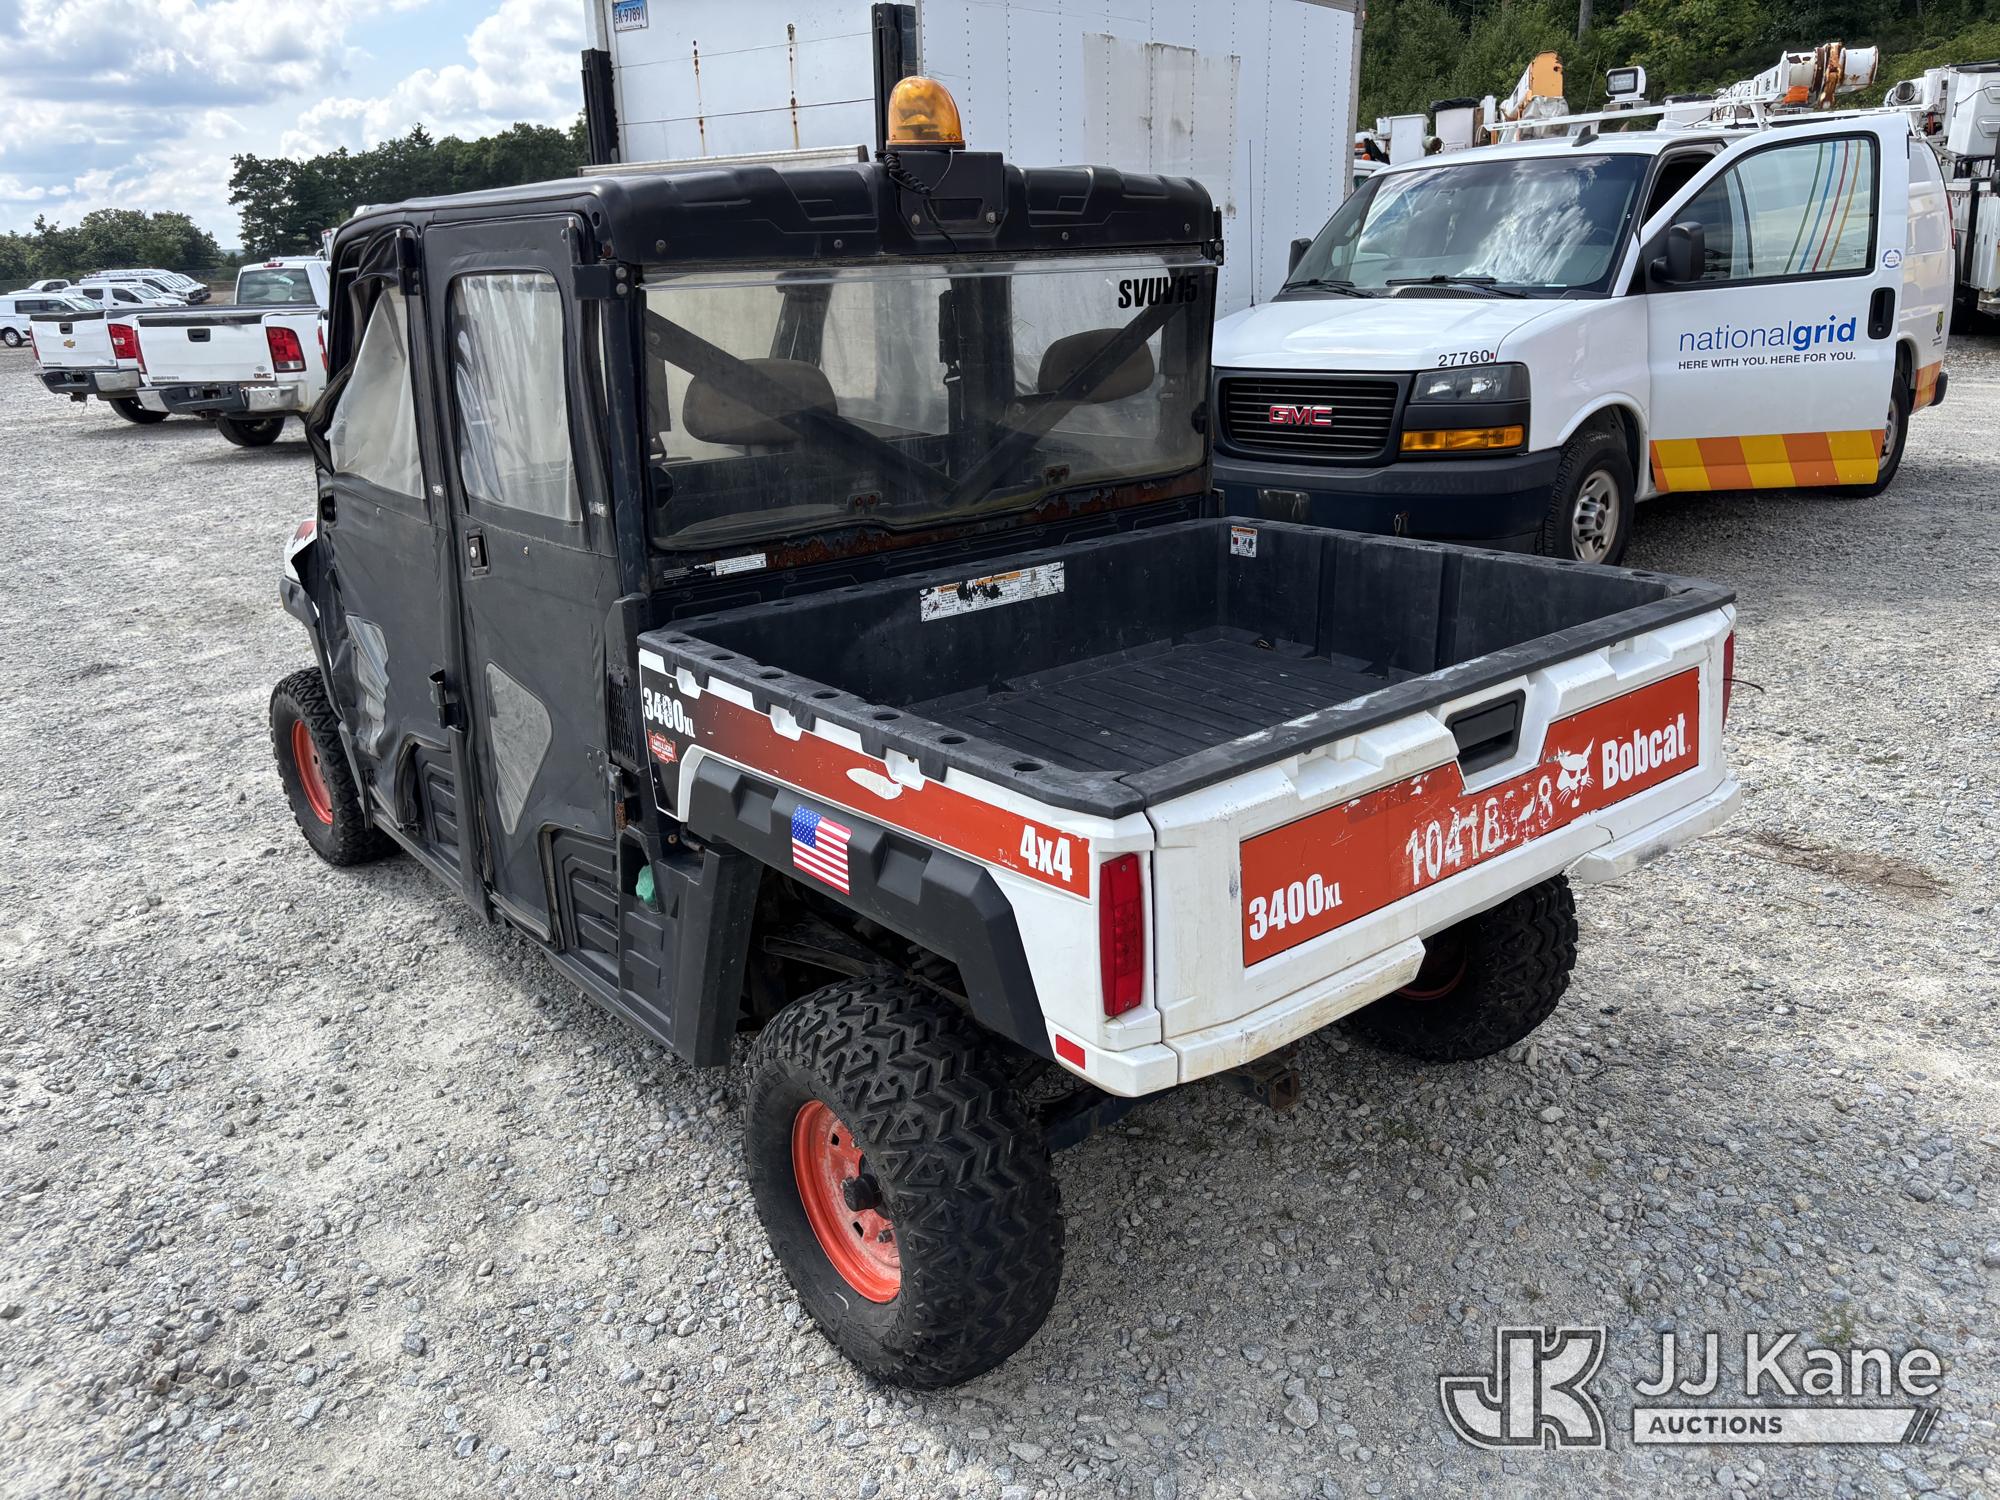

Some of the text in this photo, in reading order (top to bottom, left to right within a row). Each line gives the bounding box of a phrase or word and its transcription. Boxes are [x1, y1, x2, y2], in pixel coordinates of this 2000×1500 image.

[1118, 275, 1198, 309] SVUV15
[1679, 315, 1856, 351] nationalgrid
[1438, 350, 1490, 366] 27760
[1678, 350, 1856, 370] HERE WITH YOU. HERE FOR YOU.
[1269, 405, 1332, 425] GMC
[1602, 712, 1686, 790] Bobcat
[1020, 824, 1072, 882] 4x4
[1249, 873, 1343, 940] 3400XL
